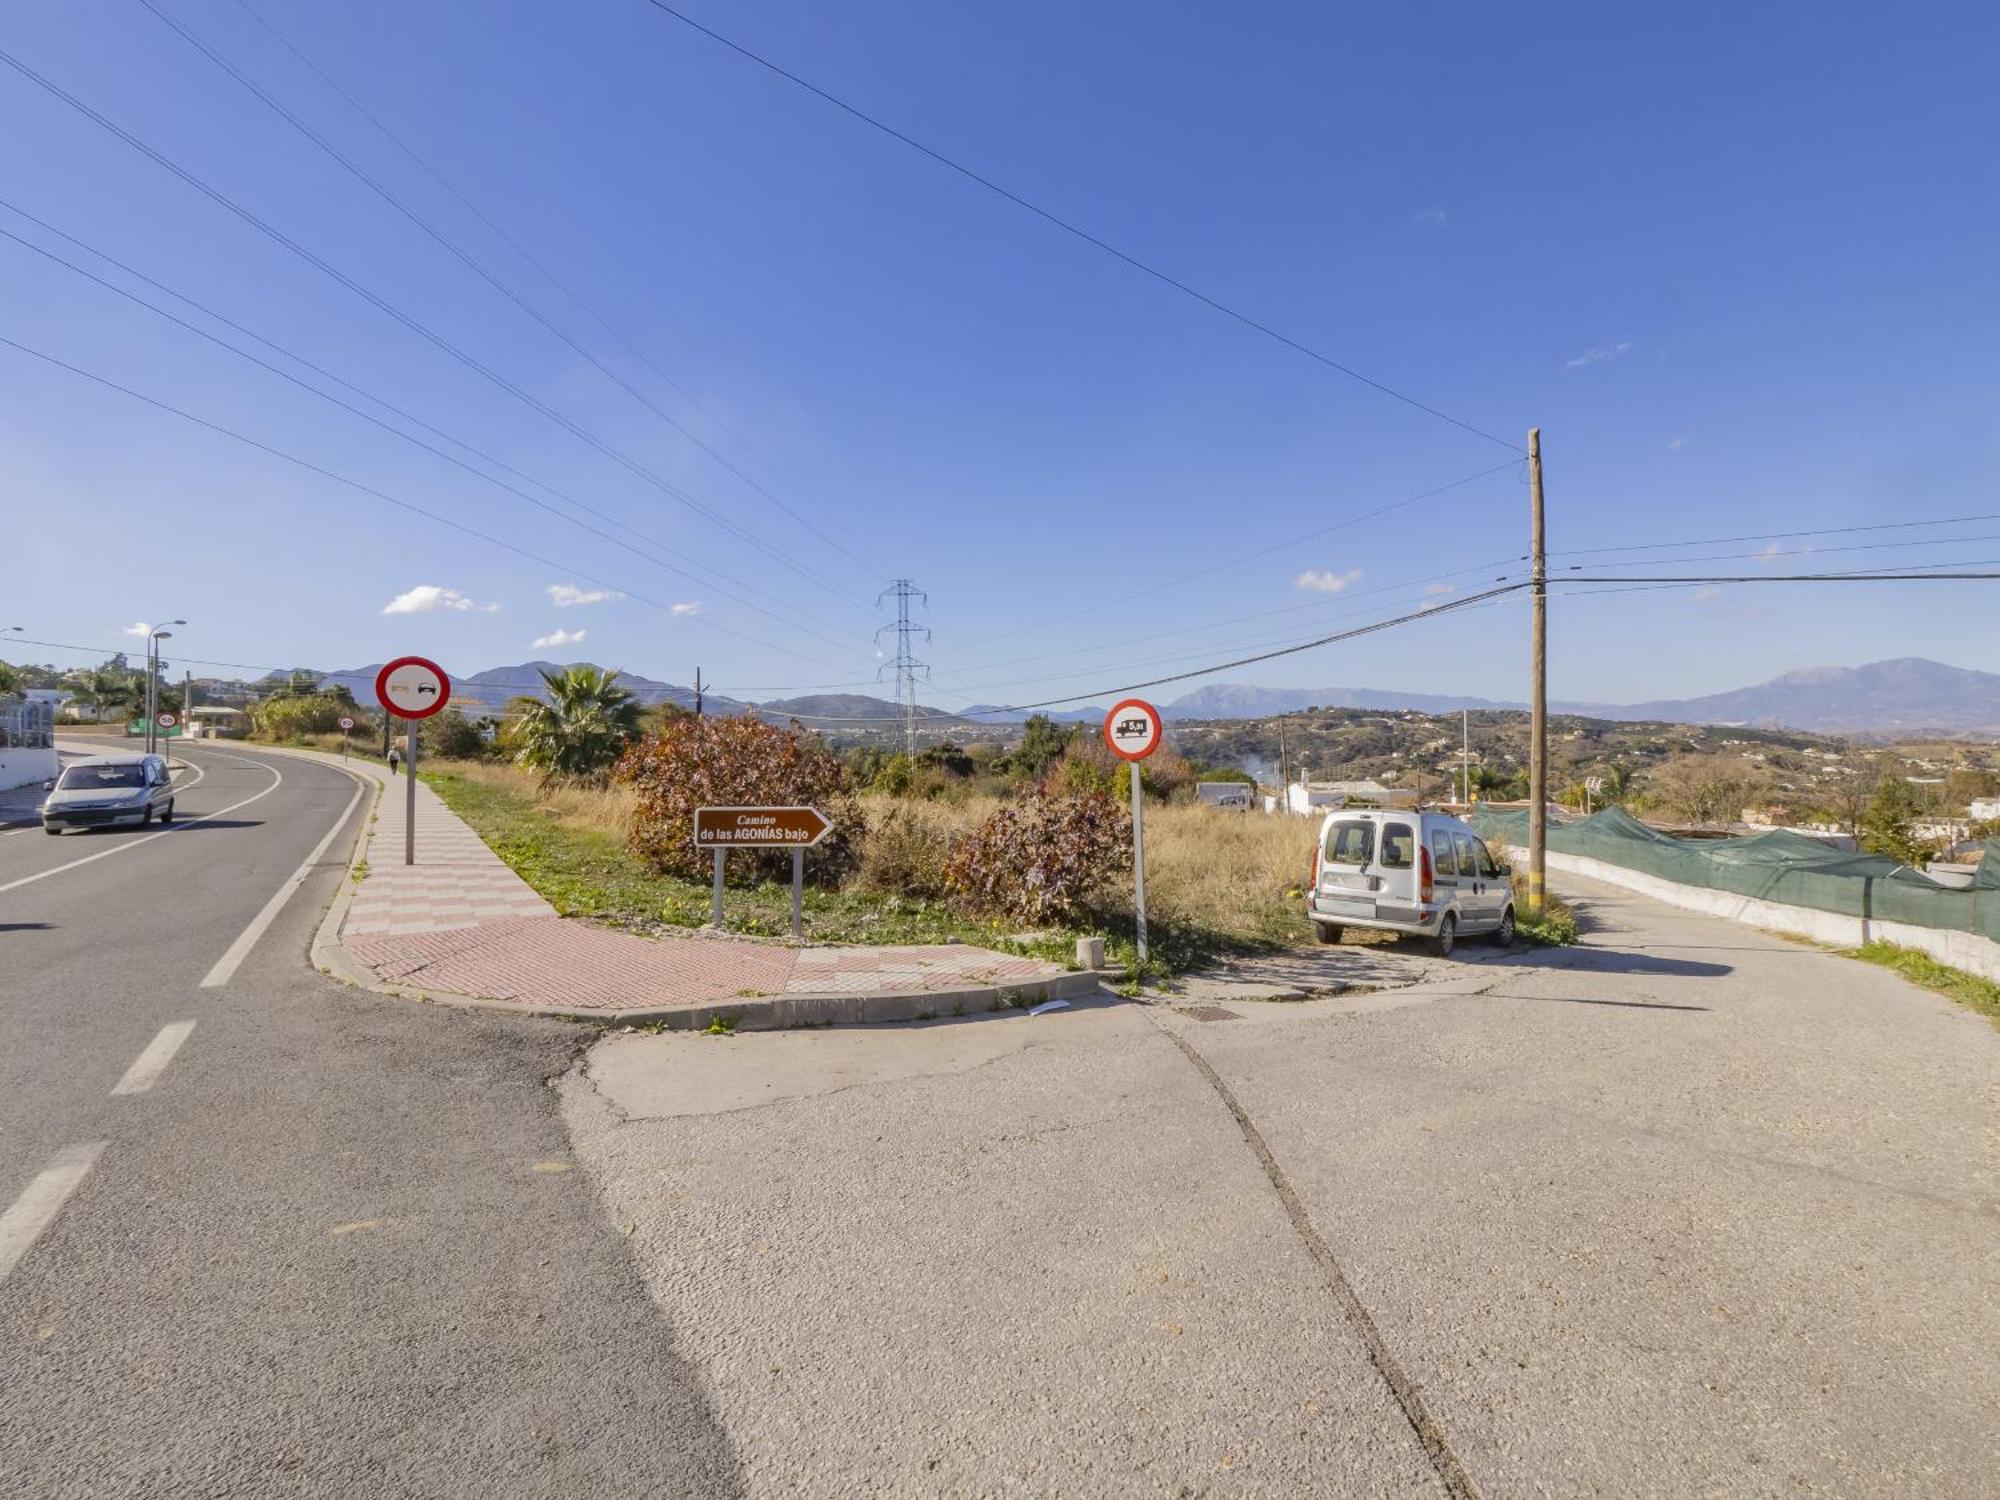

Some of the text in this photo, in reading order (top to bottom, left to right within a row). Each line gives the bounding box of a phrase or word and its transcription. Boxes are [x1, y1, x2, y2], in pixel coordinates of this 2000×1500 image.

[737, 815, 776, 825] Camino
[701, 825, 809, 841] de las AGONÍAS bajo
